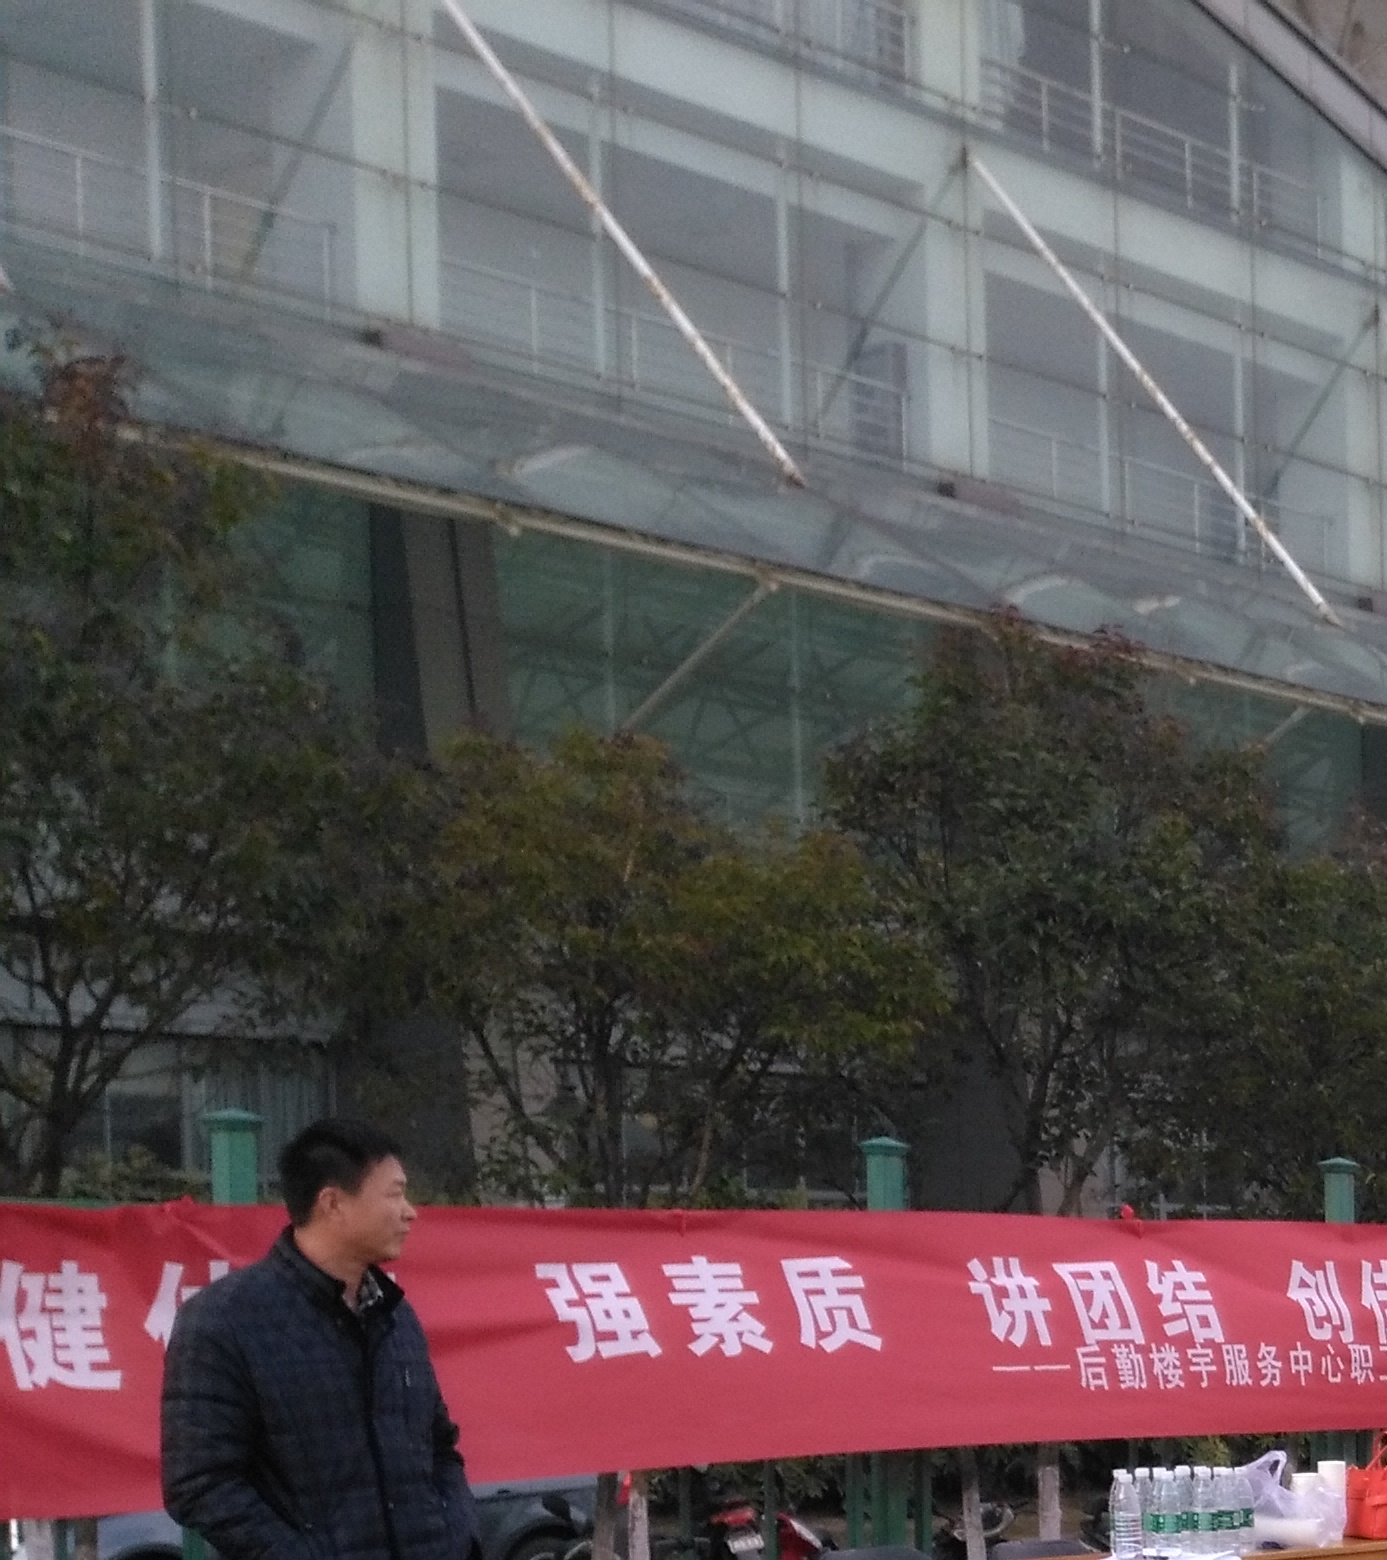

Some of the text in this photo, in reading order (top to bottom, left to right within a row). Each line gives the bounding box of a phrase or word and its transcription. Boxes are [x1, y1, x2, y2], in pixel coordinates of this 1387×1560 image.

[535, 1256, 882, 1363] 强素质
[967, 1256, 1225, 1347] 讲团结
